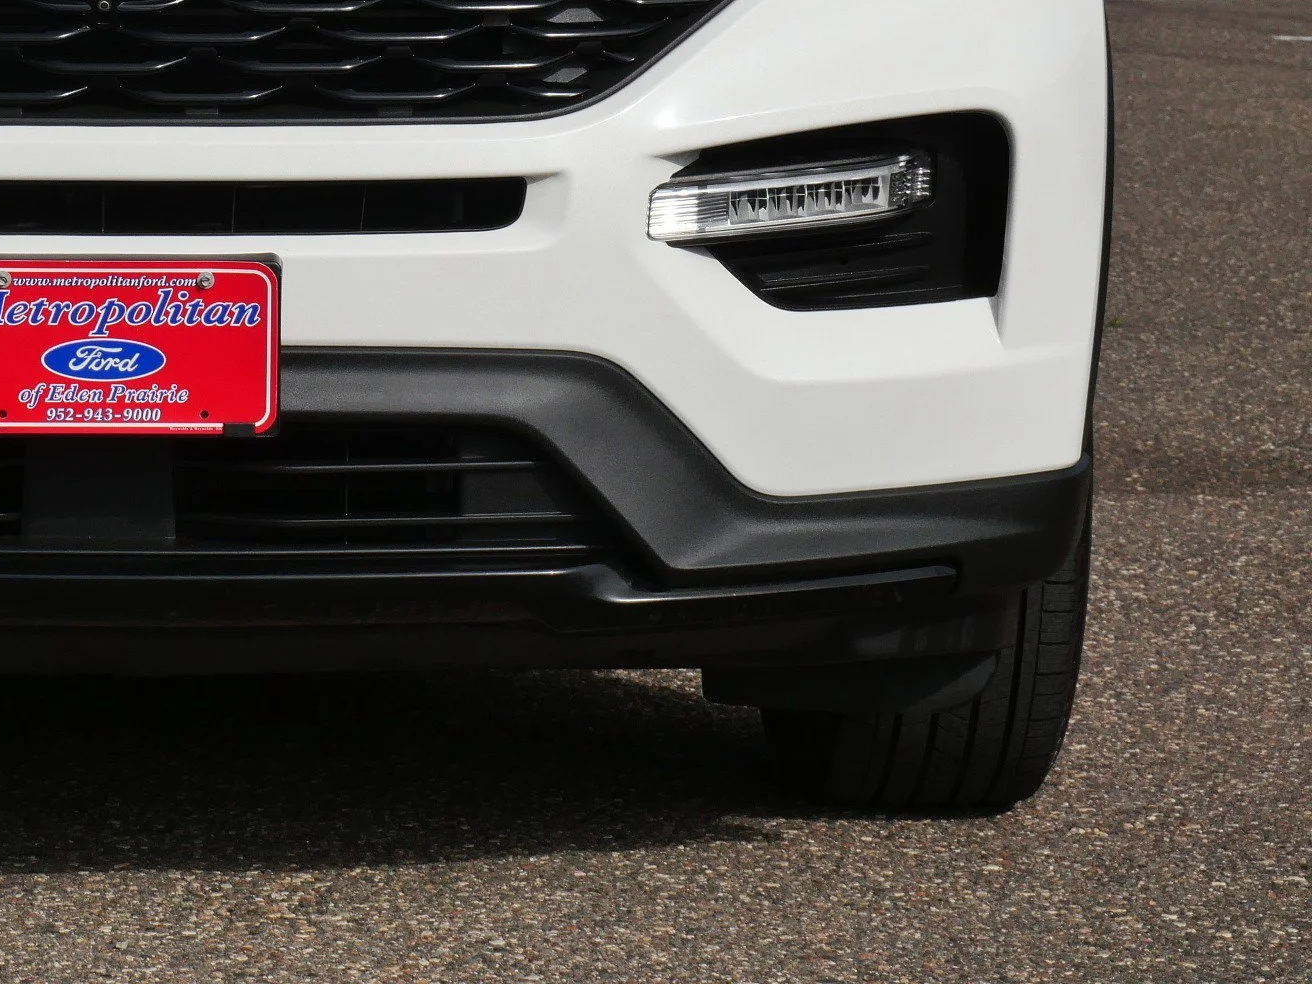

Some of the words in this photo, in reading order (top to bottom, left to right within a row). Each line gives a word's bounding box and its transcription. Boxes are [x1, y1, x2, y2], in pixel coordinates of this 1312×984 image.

[13, 274, 197, 290] www.metropolitanford.com
[68, 344, 140, 372] Ford
[18, 384, 46, 409] of
[46, 383, 103, 403] Eden
[107, 383, 189, 403] Prairie
[46, 407, 162, 422] 952-943-9000
